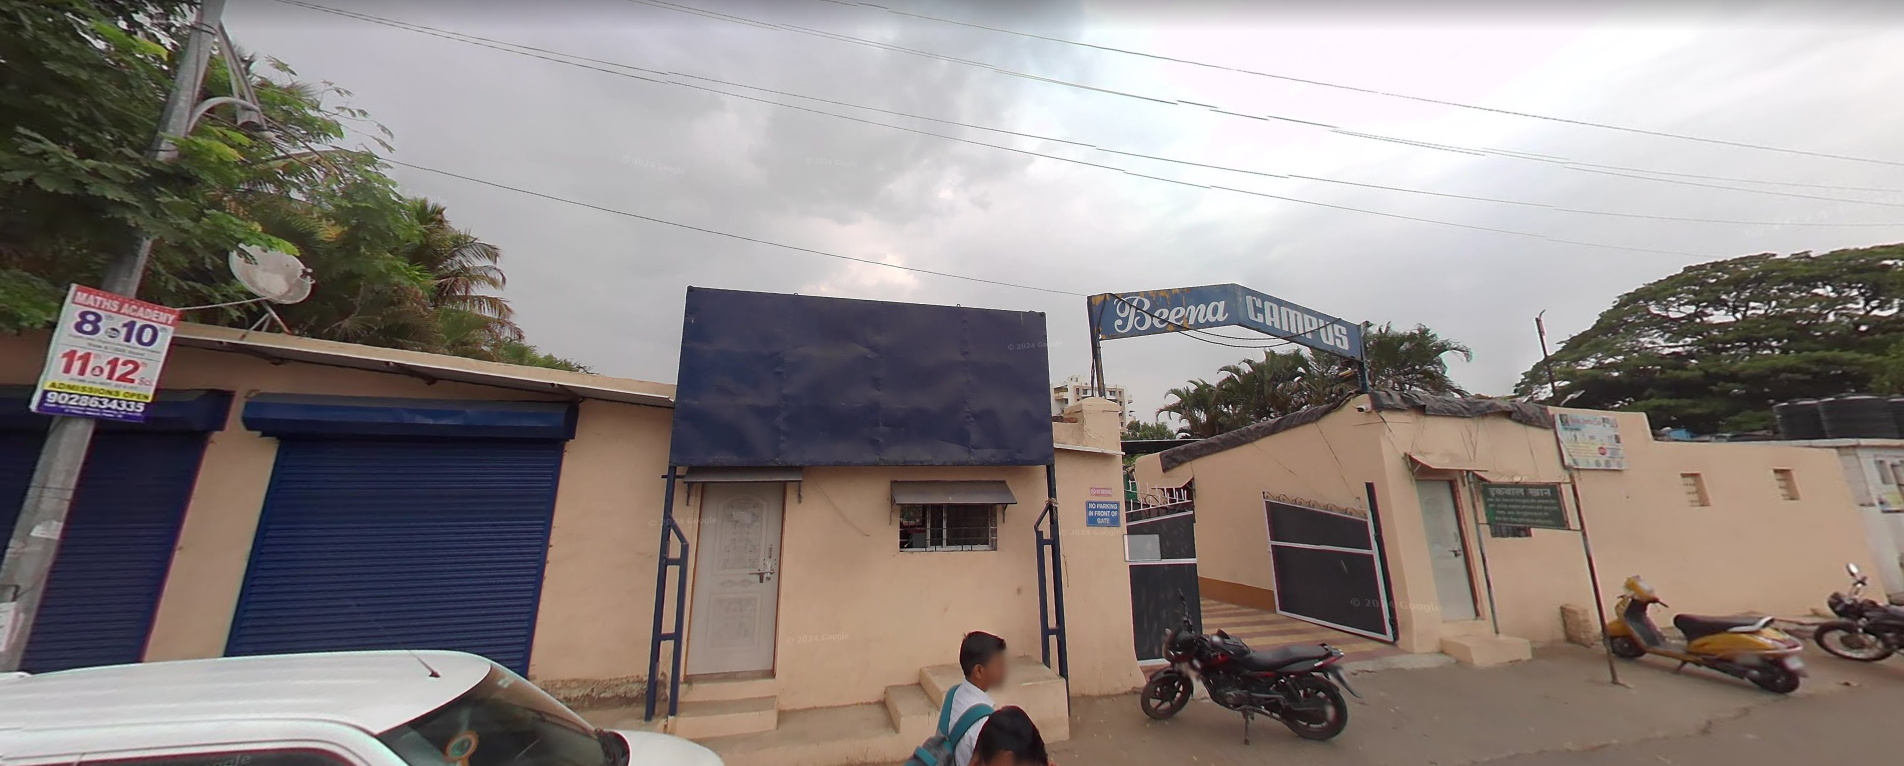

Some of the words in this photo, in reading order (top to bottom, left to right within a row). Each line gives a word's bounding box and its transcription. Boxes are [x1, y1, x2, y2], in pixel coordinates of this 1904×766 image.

[74, 291, 120, 312] MATHS
[120, 301, 176, 325] ACADEMY
[1113, 295, 1229, 333] Beena
[1246, 295, 1350, 350] CAMPUS
[46, 392, 145, 413] 9028634335
[50, 382, 119, 397] ADMISSIONS
[123, 391, 150, 401] OPEN
